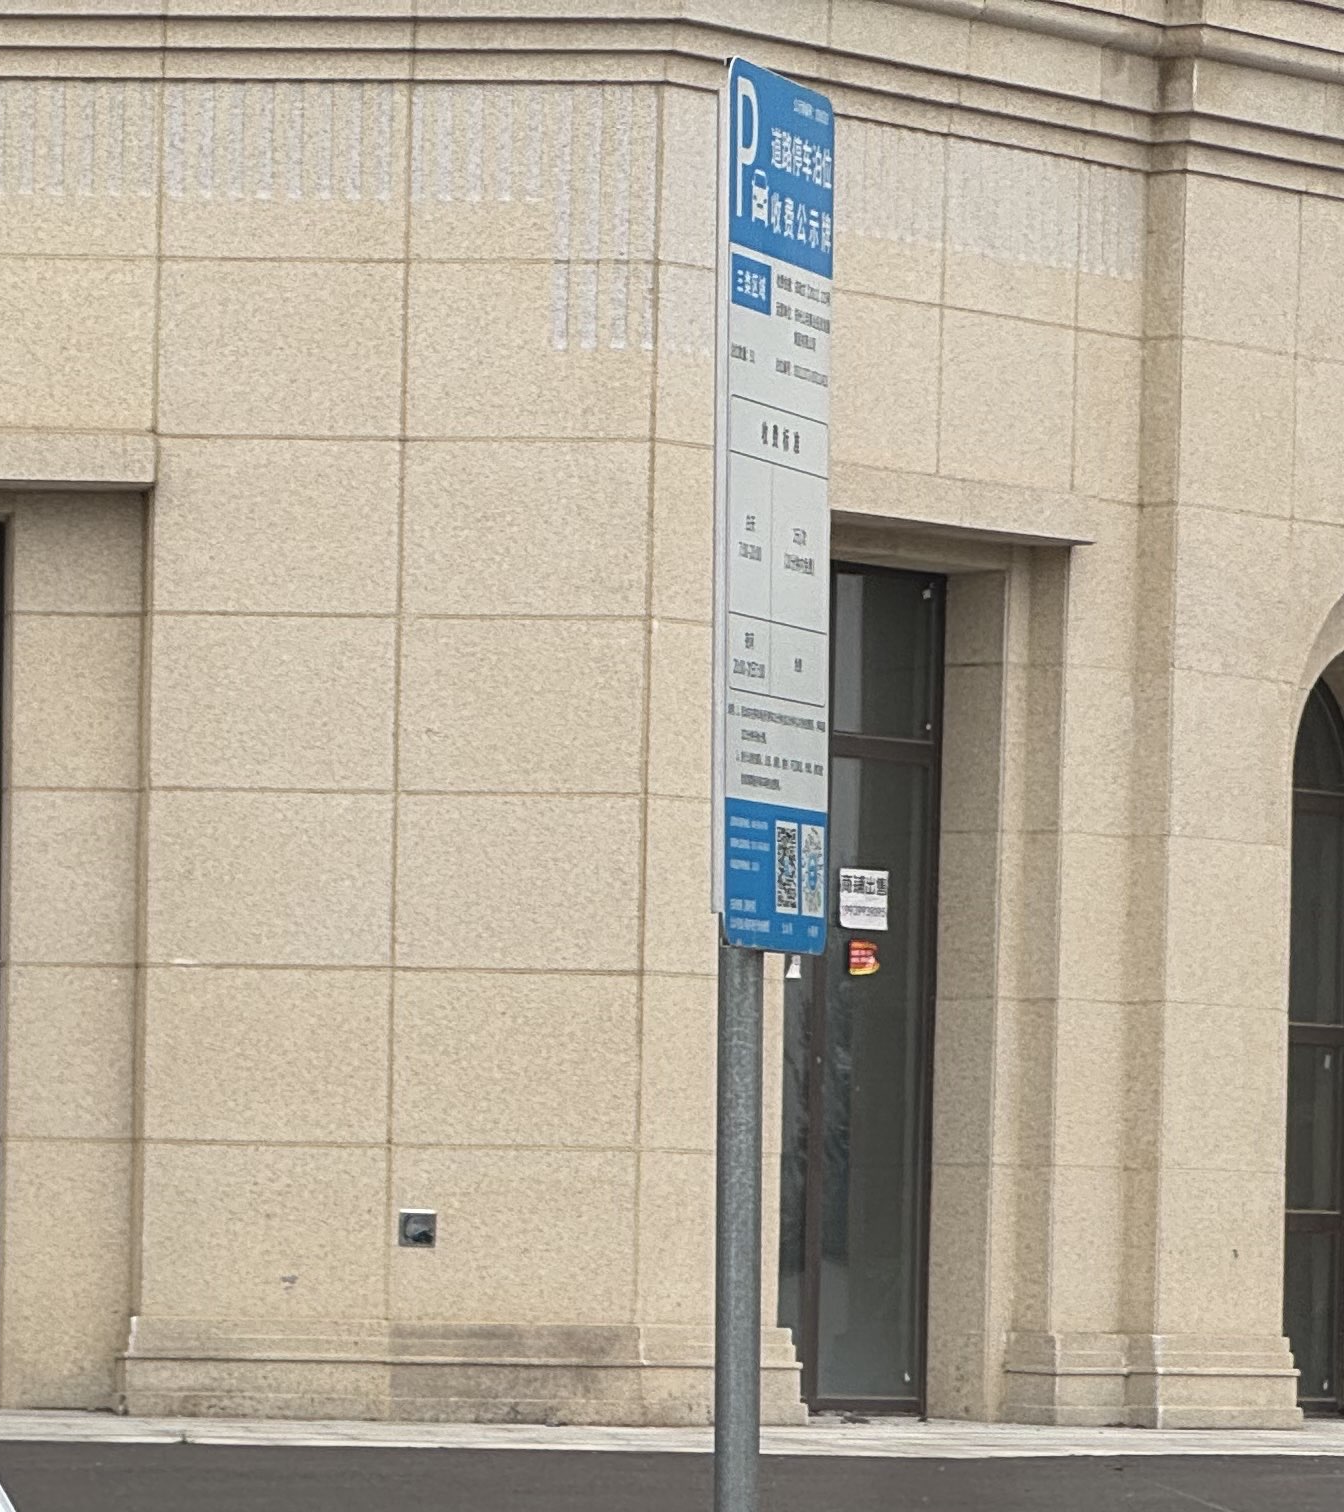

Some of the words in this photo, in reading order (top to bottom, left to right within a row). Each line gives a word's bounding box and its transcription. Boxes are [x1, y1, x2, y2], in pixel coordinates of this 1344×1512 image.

[736, 76, 759, 218] P
[770, 127, 832, 189] 道路停车泊位
[770, 192, 832, 254] 收费公示牌
[736, 269, 766, 302] 三类区域
[840, 874, 888, 896] 商铺出售
